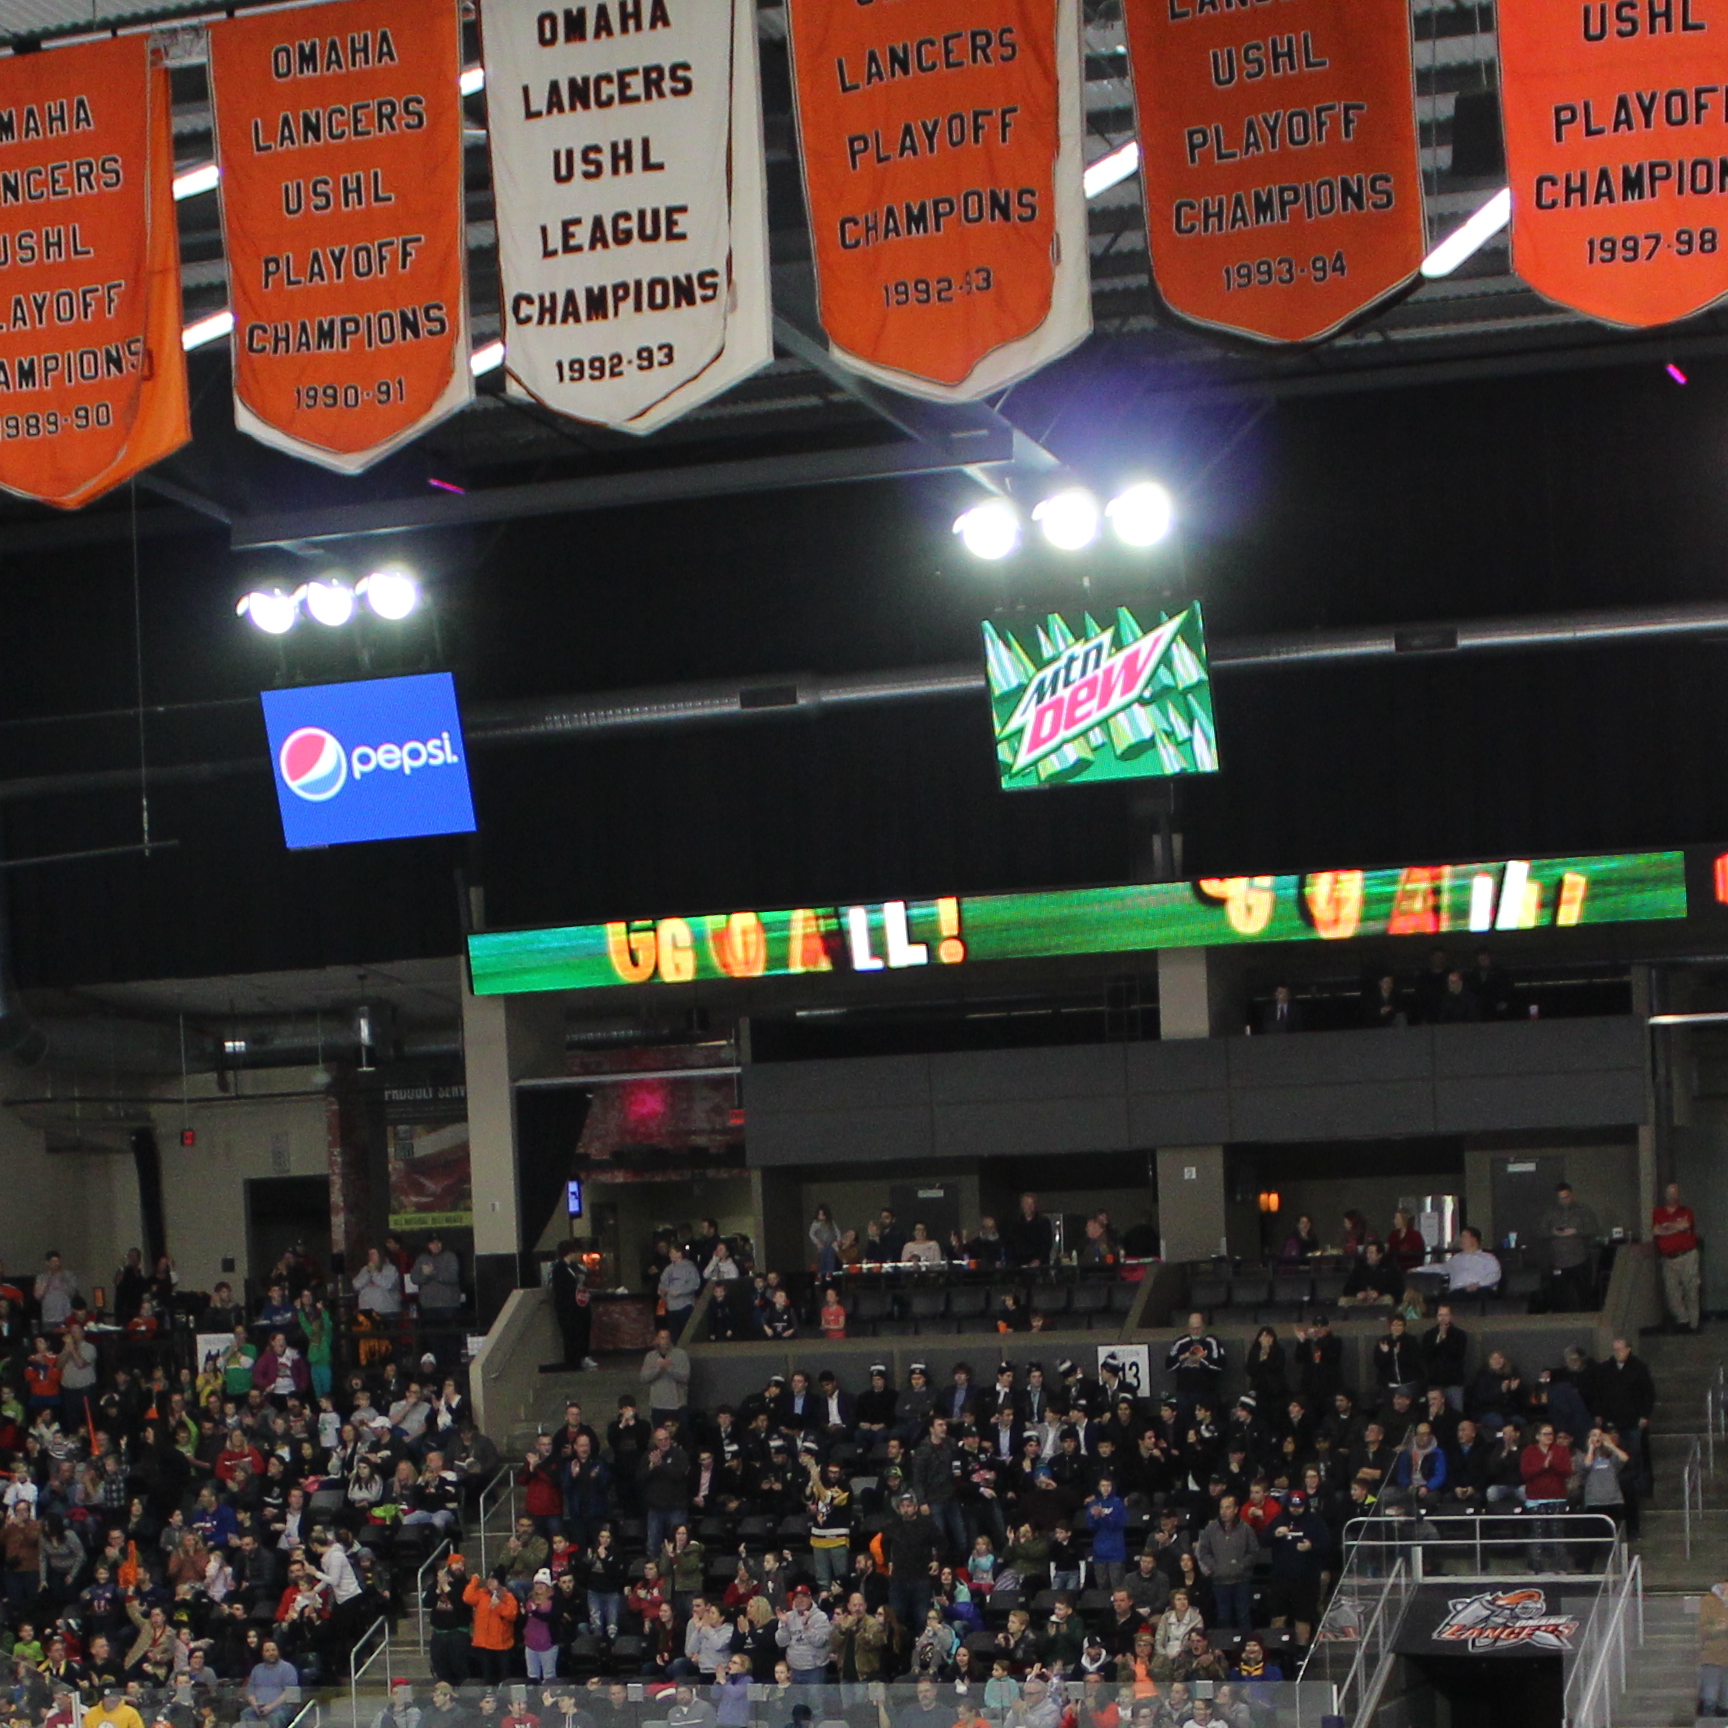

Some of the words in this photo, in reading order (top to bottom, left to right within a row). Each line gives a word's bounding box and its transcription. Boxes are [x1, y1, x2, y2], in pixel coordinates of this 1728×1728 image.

[536, 0, 672, 49] OMAHA
[1583, 0, 1707, 43] USHL
[271, 27, 397, 80] OMAHA
[835, 25, 1018, 95] LANCERS
[1210, 30, 1329, 88] USHL
[522, 63, 695, 121] LANCERS
[251, 94, 427, 154] LANCERS
[848, 105, 1020, 171] PLAYOFF
[1186, 102, 1367, 166] PLAYOFF
[552, 135, 666, 186] USHL
[282, 169, 395, 217] USHL
[1172, 172, 1395, 237] CHAMPIONS
[539, 206, 689, 260] LEAGUE
[1585, 225, 1719, 266] 1997-98
[261, 235, 424, 291] PLAYOFF
[1223, 250, 1348, 292] 1993-94
[511, 269, 721, 328] CHAMPIONS
[246, 302, 448, 358] CHAMPIONS
[554, 342, 675, 385] 1992-93
[294, 377, 407, 413] 1990-91
[1441, 1621, 1580, 1640] LANCERS
